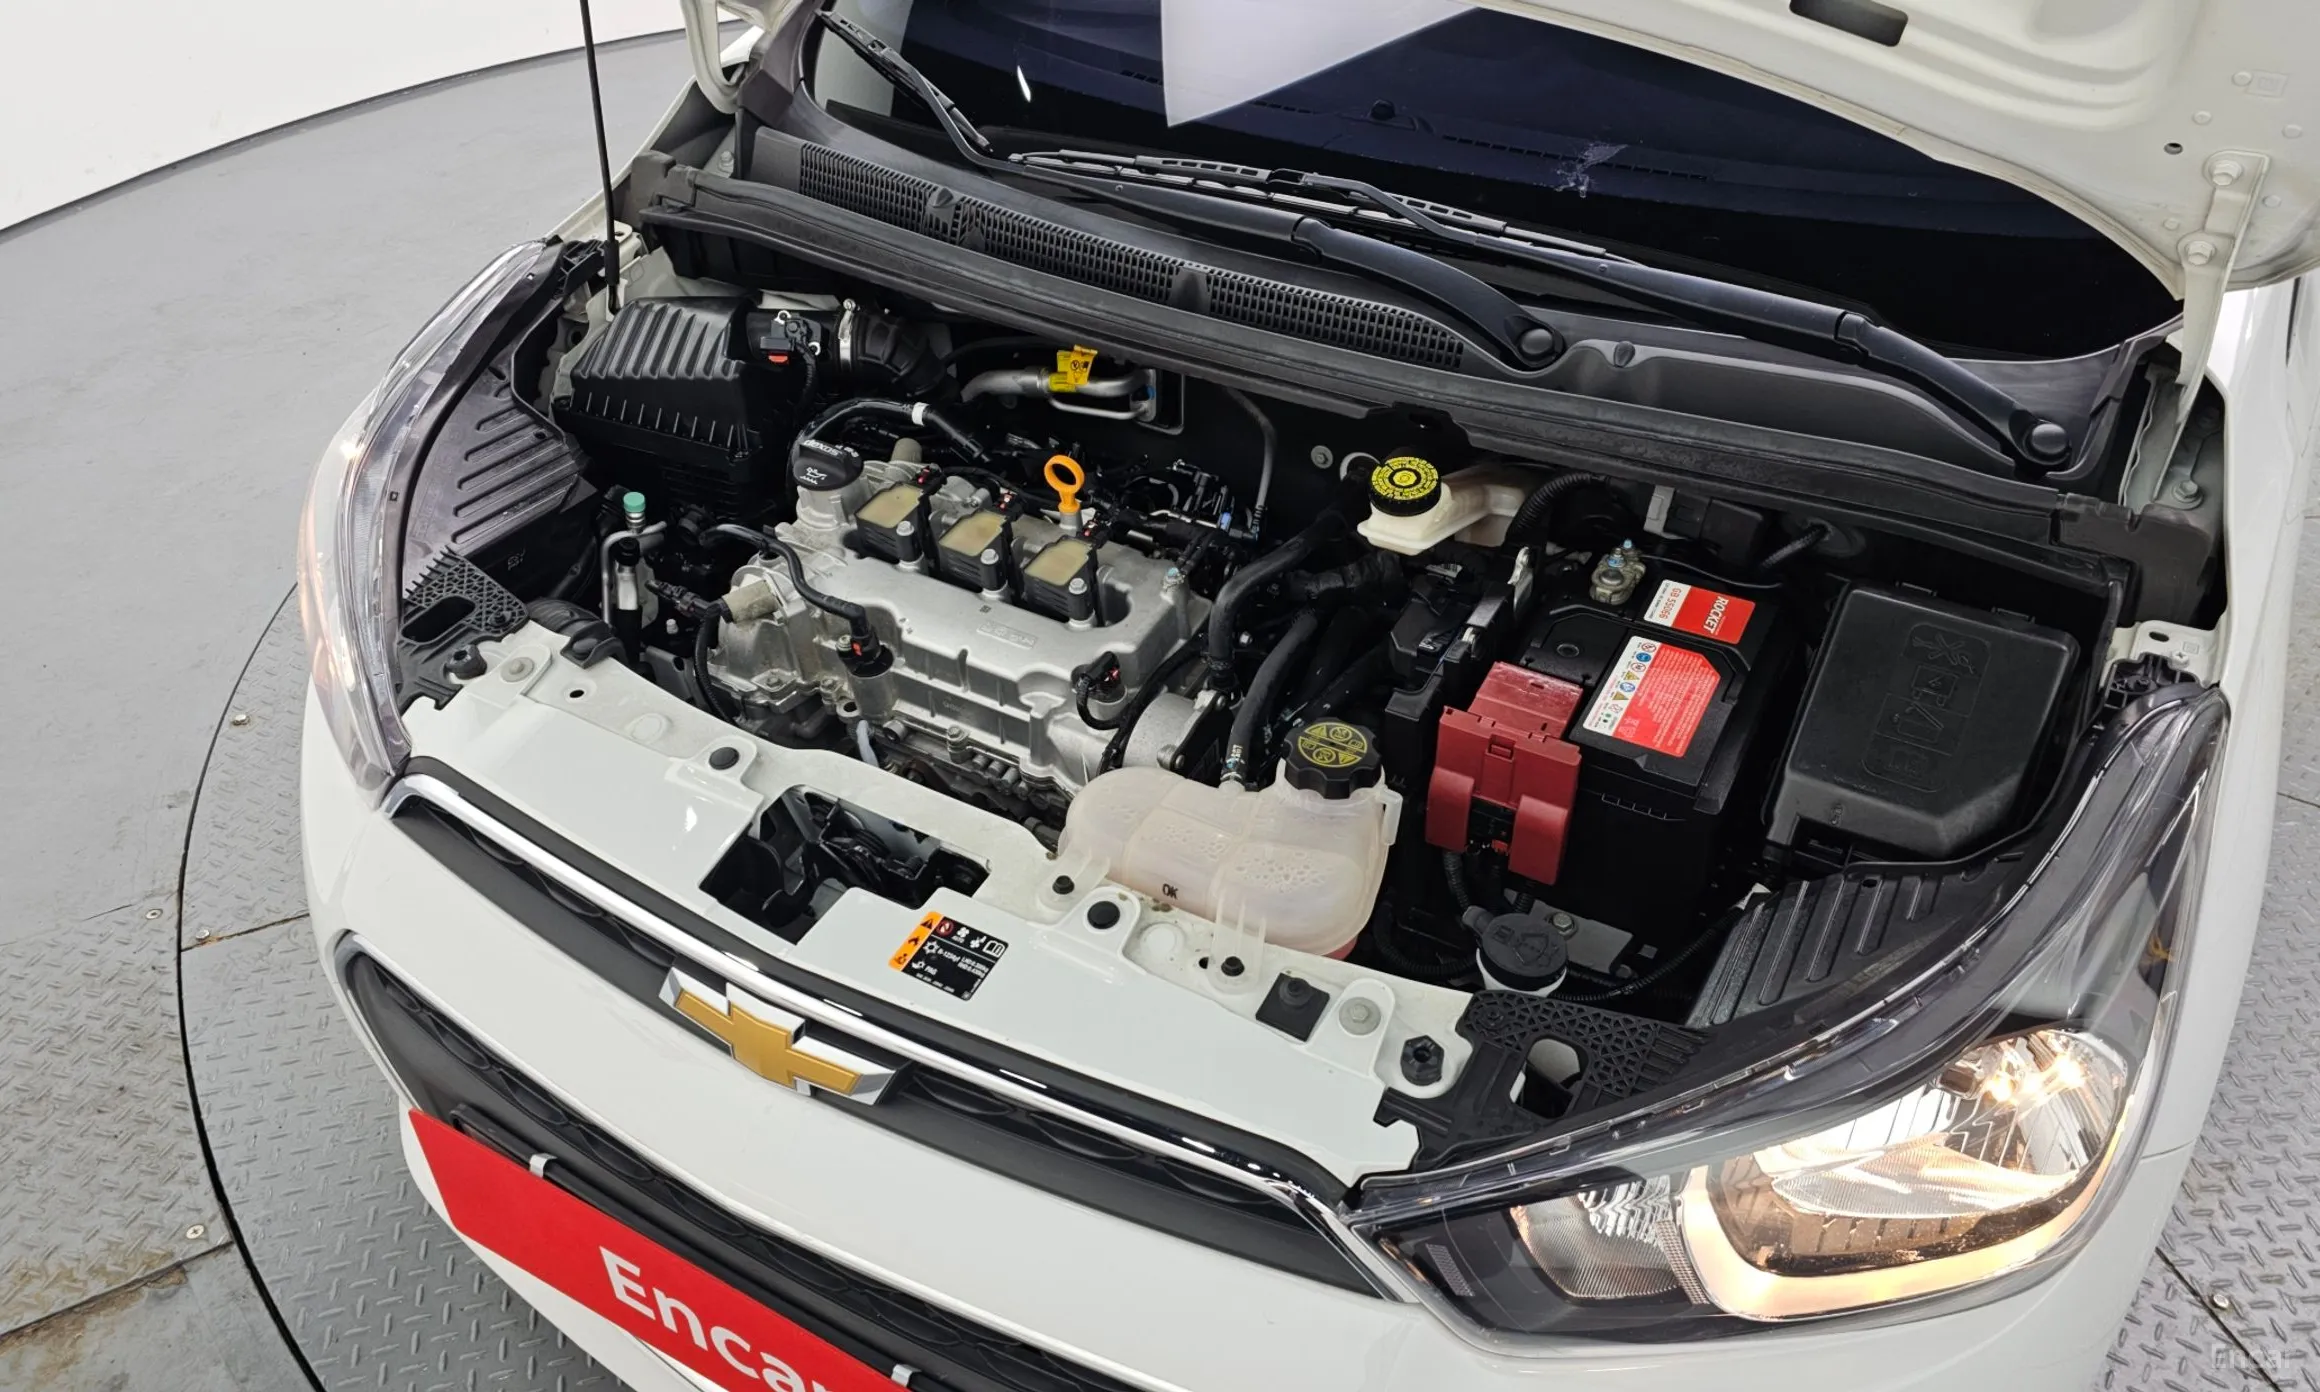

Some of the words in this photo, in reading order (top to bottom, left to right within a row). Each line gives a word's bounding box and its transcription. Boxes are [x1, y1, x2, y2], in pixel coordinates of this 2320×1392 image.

[803, 439, 839, 456] dexos
[1703, 595, 1729, 634] ROCKET
[1162, 883, 1179, 899] OK
